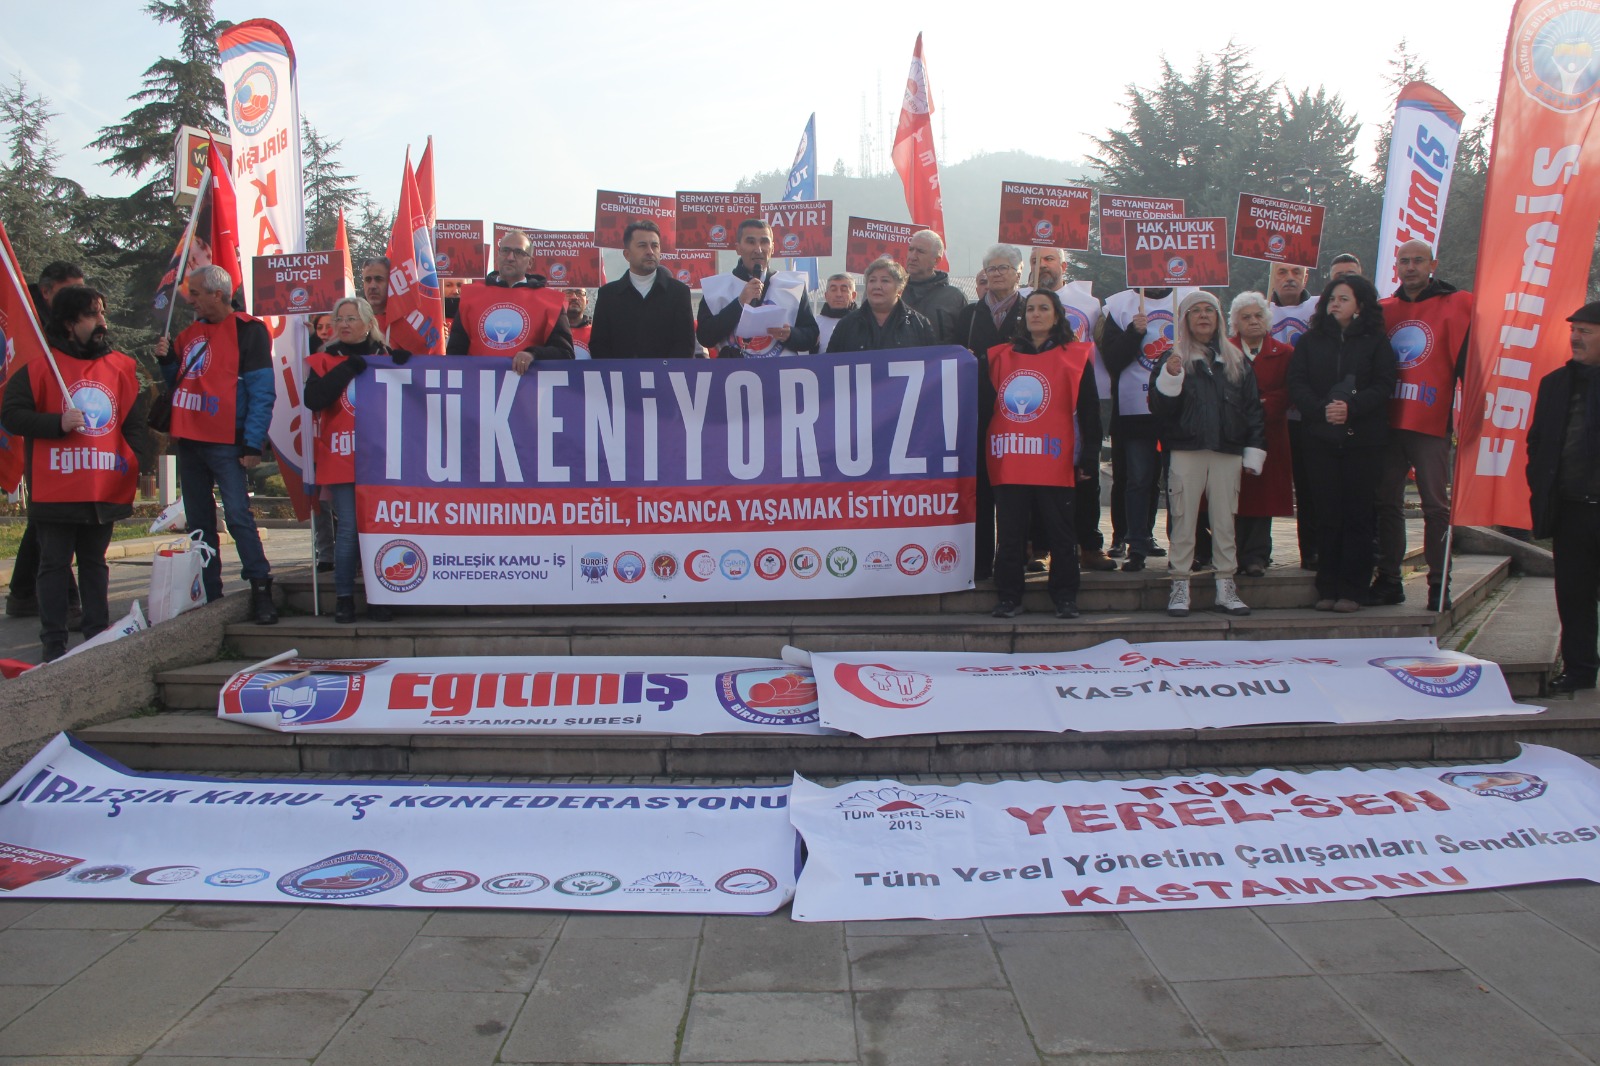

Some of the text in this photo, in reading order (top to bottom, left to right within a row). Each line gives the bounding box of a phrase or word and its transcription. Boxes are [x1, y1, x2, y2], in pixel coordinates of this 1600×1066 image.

[679, 195, 730, 205] SERMAYEYE
[1045, 188, 1089, 200] YAŞAMAK
[727, 203, 755, 214] BÜTÇE
[760, 202, 779, 211] ÇLIĞA
[779, 203, 787, 211] VE
[1111, 199, 1174, 211] SEYYANEN ZAM
[1136, 221, 1215, 235] HAK, HUKUK
[1255, 219, 1303, 236] OYNAMA
[1135, 234, 1216, 251] ADALET!
[267, 256, 302, 269] HALK
[659, 251, 712, 261] OKSUL OLAMAZ!
[275, 269, 321, 284] BÜTÇE!
[375, 490, 959, 528] AÇLIK SINIRINDA DEĞİL, İNSANCA YAŞAMAK İSTİYORUZ
[432, 553, 496, 569] BİRLEŞİK
[499, 555, 541, 567] KAMU
[553, 553, 566, 568] İŞ
[432, 570, 549, 580] KONFEDERASYONU
[1055, 679, 1291, 700] KASTAMONU
[421, 717, 558, 726] KASTAMONU
[1120, 777, 1298, 800] TÜM
[389, 794, 788, 811] KONFEDERASYONU
[842, 809, 966, 821] TÜM YEREL-SEN
[1005, 789, 1452, 837] YEREL-SEN
[888, 820, 923, 831] 2013
[854, 869, 941, 887] Tüm
[951, 857, 1054, 883] Yerel
[1063, 848, 1225, 877] Yönetim
[1234, 837, 1427, 869] Çalışanları
[1061, 865, 1469, 908] KASTAMONU
